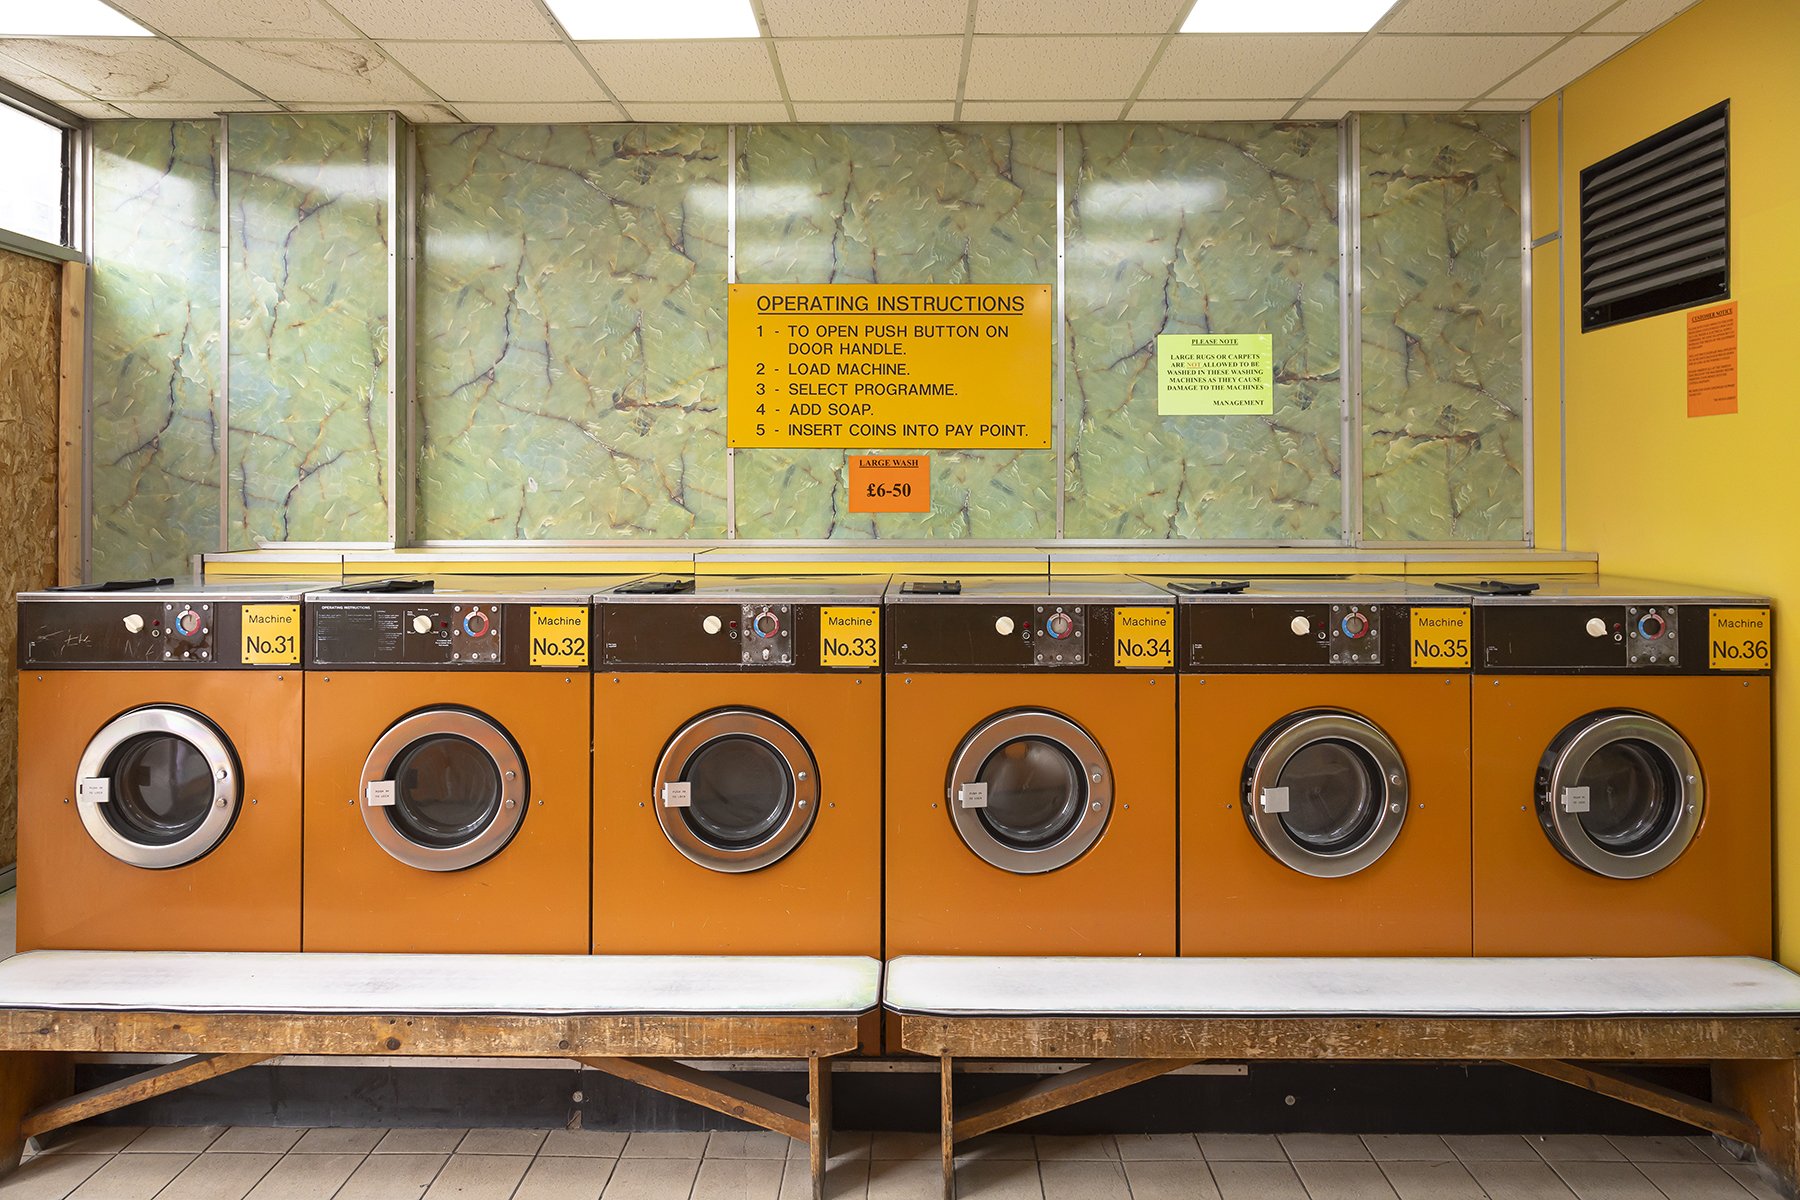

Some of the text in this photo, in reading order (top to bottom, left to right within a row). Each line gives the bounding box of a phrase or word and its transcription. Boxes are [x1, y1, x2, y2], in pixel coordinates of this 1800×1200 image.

[757, 296, 1024, 311] OPERATING INSTRUCTIONS
[1715, 308, 1732, 317] NOTICE
[757, 325, 762, 337] 1
[788, 325, 809, 337] TO
[816, 325, 858, 337] OPEN
[865, 325, 907, 337] PUSH
[915, 325, 978, 337] BUTTON
[986, 325, 1008, 337] ON
[789, 343, 906, 355] DOOR HANDLE.
[757, 363, 765, 375] 2
[789, 363, 830, 375] LOAD
[837, 363, 909, 375] MACHINE.
[756, 383, 765, 395] 3
[789, 383, 848, 395] SELECT
[855, 383, 957, 395] PROGRAMME.
[756, 404, 765, 415] 4
[790, 404, 821, 415] ADD
[828, 403, 873, 416] SOAP.
[756, 424, 765, 436] 5
[789, 424, 842, 436] INSERT
[849, 424, 896, 436] COINS
[903, 424, 939, 436] INTO
[946, 425, 973, 436] PAY
[981, 424, 1028, 436] POINT.
[859, 459, 919, 468] LARGE WASH
[867, 483, 911, 497] £6-50
[249, 614, 292, 623] Machine
[538, 617, 581, 625] Machine
[829, 617, 872, 626] Machine
[1123, 617, 1166, 626] Machine
[1419, 618, 1463, 627] Machine
[1718, 619, 1763, 628] Machine
[247, 636, 295, 653] No.31
[534, 638, 585, 656] No.32
[824, 638, 876, 656] No.33
[1118, 639, 1171, 657] No.34
[1415, 639, 1467, 657] No.35
[1713, 640, 1768, 659] No.36
